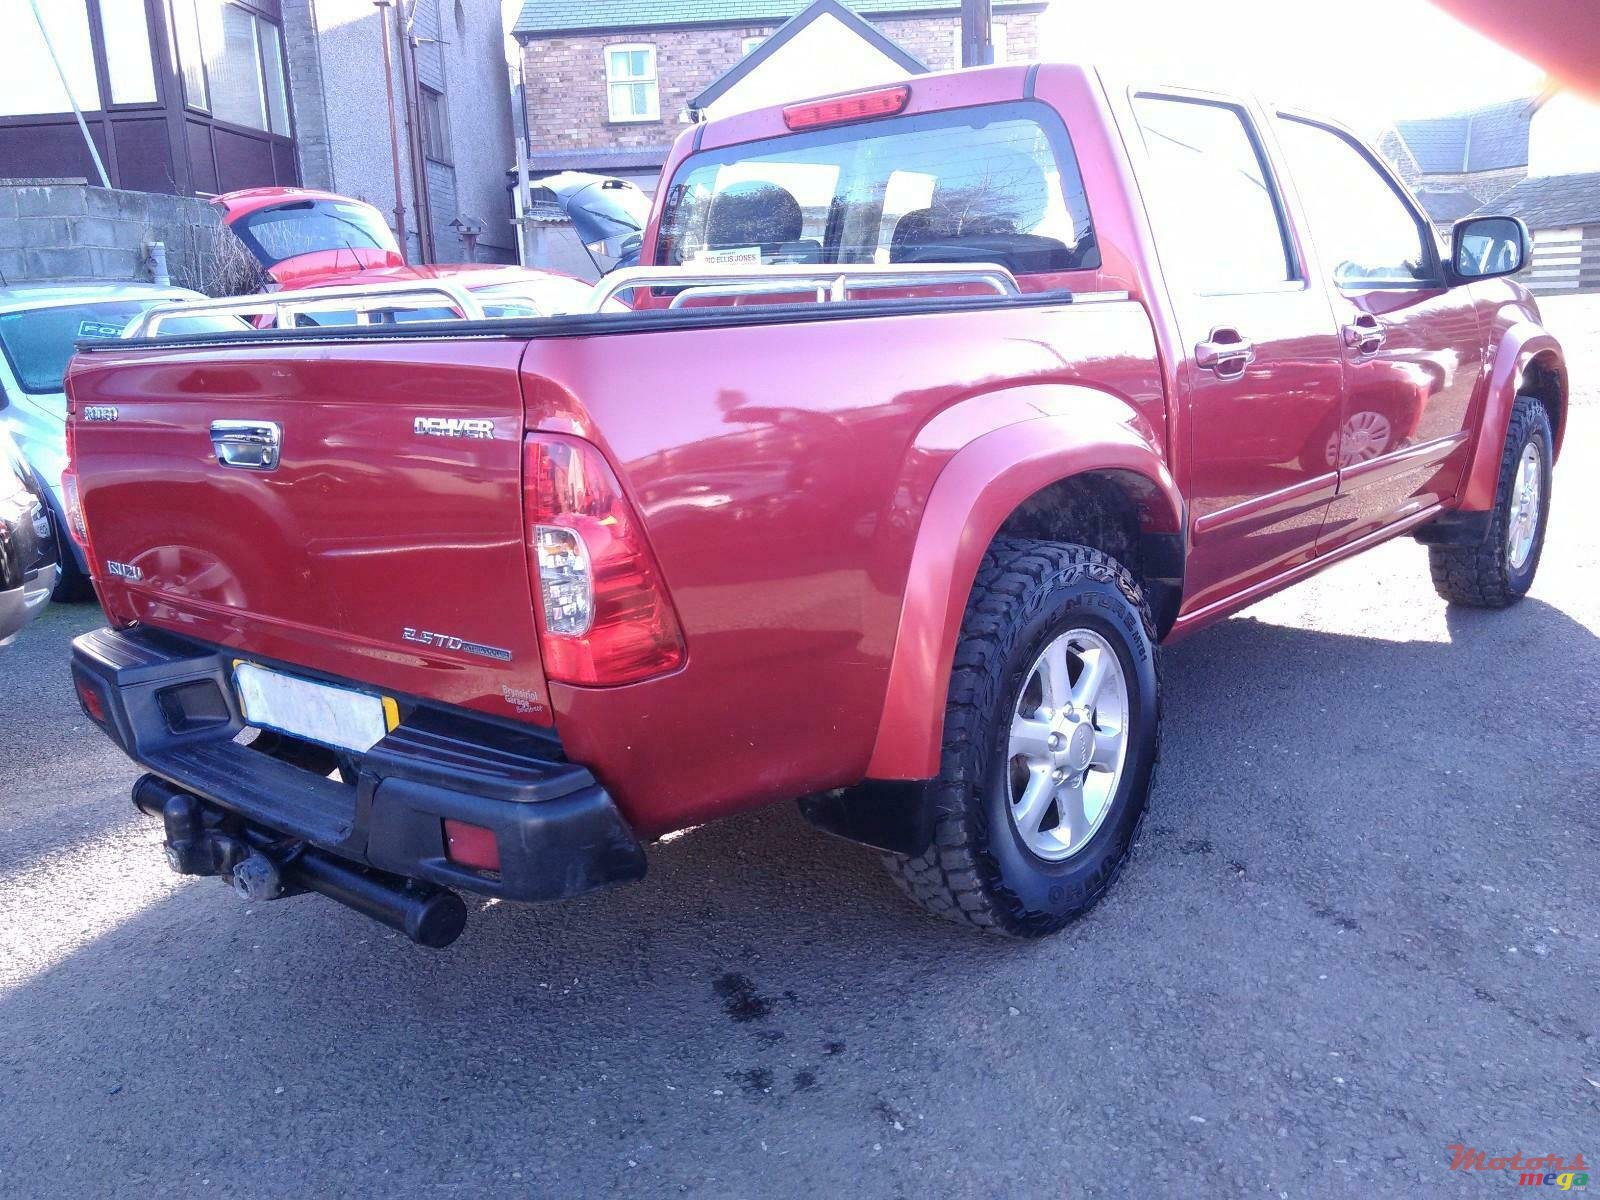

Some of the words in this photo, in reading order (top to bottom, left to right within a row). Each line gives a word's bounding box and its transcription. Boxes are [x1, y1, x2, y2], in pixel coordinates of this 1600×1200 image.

[716, 255, 733, 264] ELLIS
[734, 253, 756, 263] JONES
[414, 417, 494, 440] DENVER
[107, 560, 144, 580] ISUZU
[402, 627, 463, 650] 2.5TD
[505, 694, 530, 708] Garage
